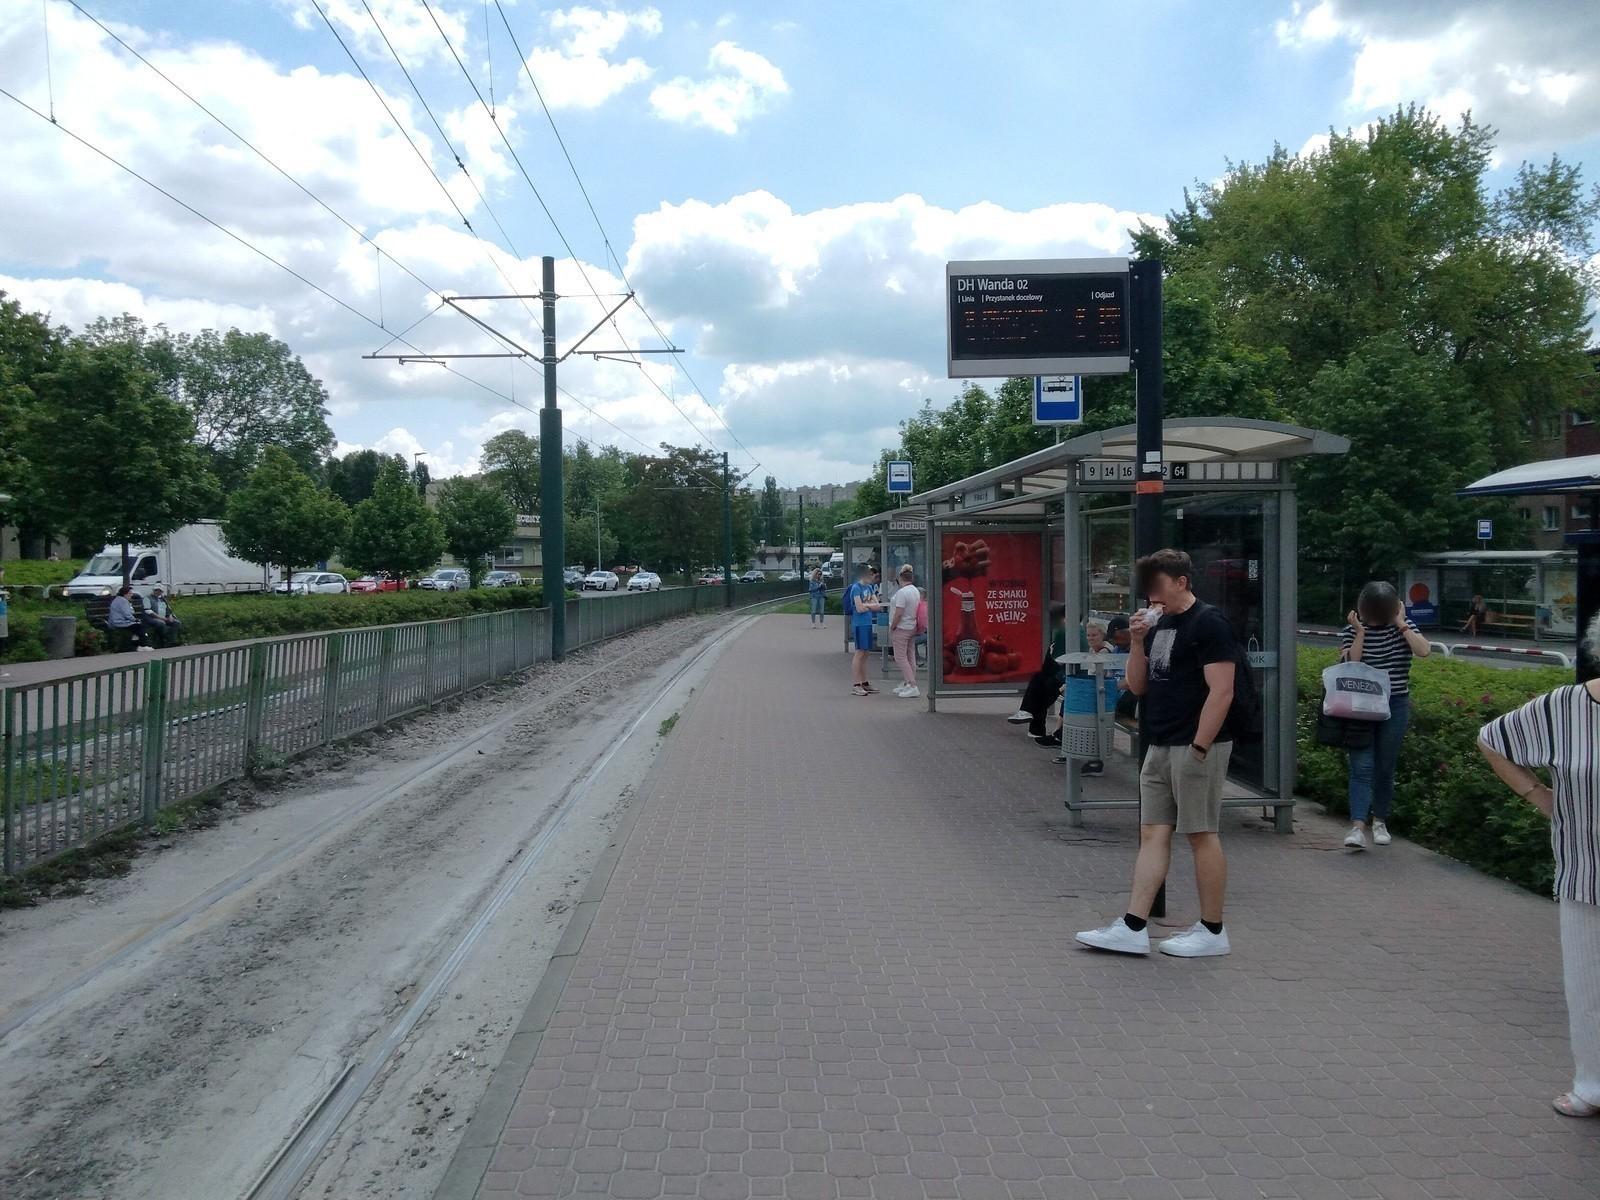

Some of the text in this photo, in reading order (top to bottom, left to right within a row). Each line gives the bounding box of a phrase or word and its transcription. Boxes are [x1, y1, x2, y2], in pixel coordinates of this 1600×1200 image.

[957, 277, 1028, 291] DH Wanda 02
[985, 294, 1043, 303] Przystanek docelowy
[1095, 291, 1115, 300] Odjazd
[1089, 467, 1095, 477] 9
[1104, 467, 1114, 477] 14
[1122, 467, 1132, 477] 16
[1174, 466, 1185, 476] 64
[987, 590, 1027, 599] ZE SMAKU
[985, 600, 1029, 609] WSZYSTKO
[996, 611, 1027, 623] HEINZ
